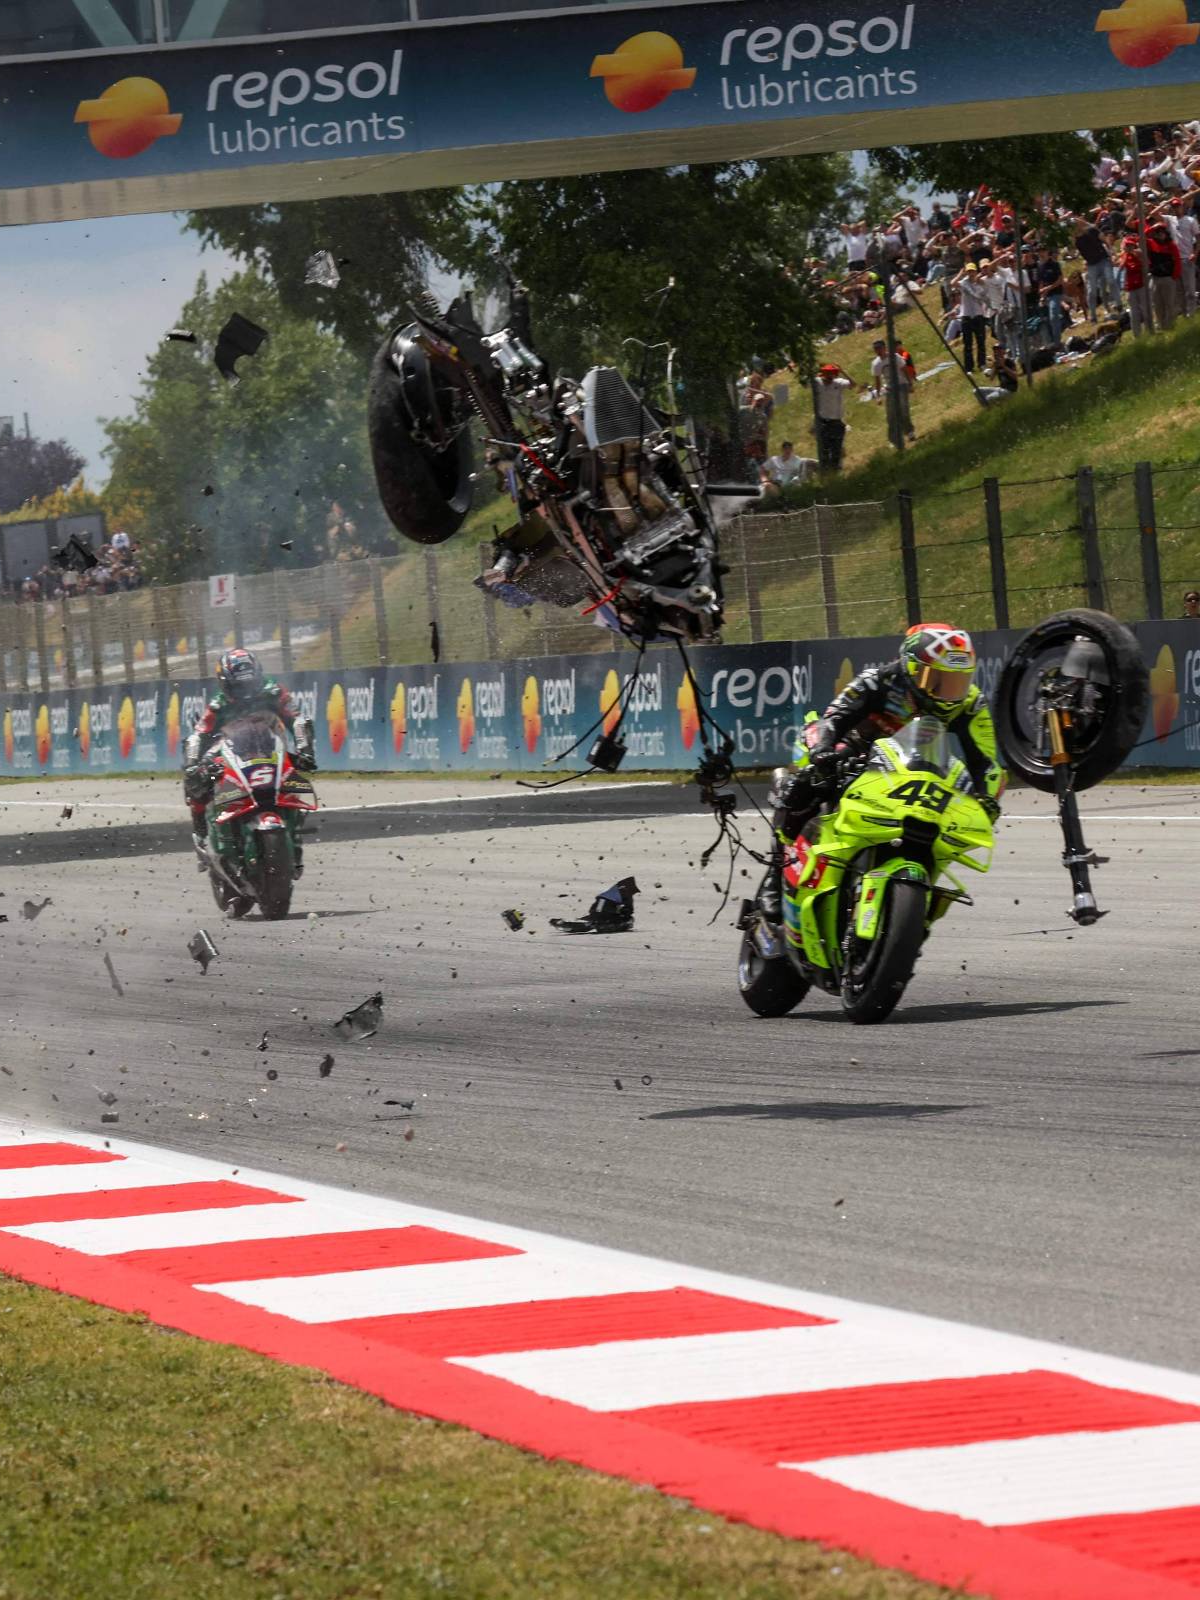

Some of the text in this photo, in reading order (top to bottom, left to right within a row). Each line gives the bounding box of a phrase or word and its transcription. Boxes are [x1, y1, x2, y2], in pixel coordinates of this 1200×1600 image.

[720, 4, 915, 71] repsol
[206, 49, 403, 116] repsol
[721, 66, 918, 110] lubricants
[208, 112, 406, 155] lubricants
[710, 654, 813, 717] repsol
[887, 779, 954, 814] 49
